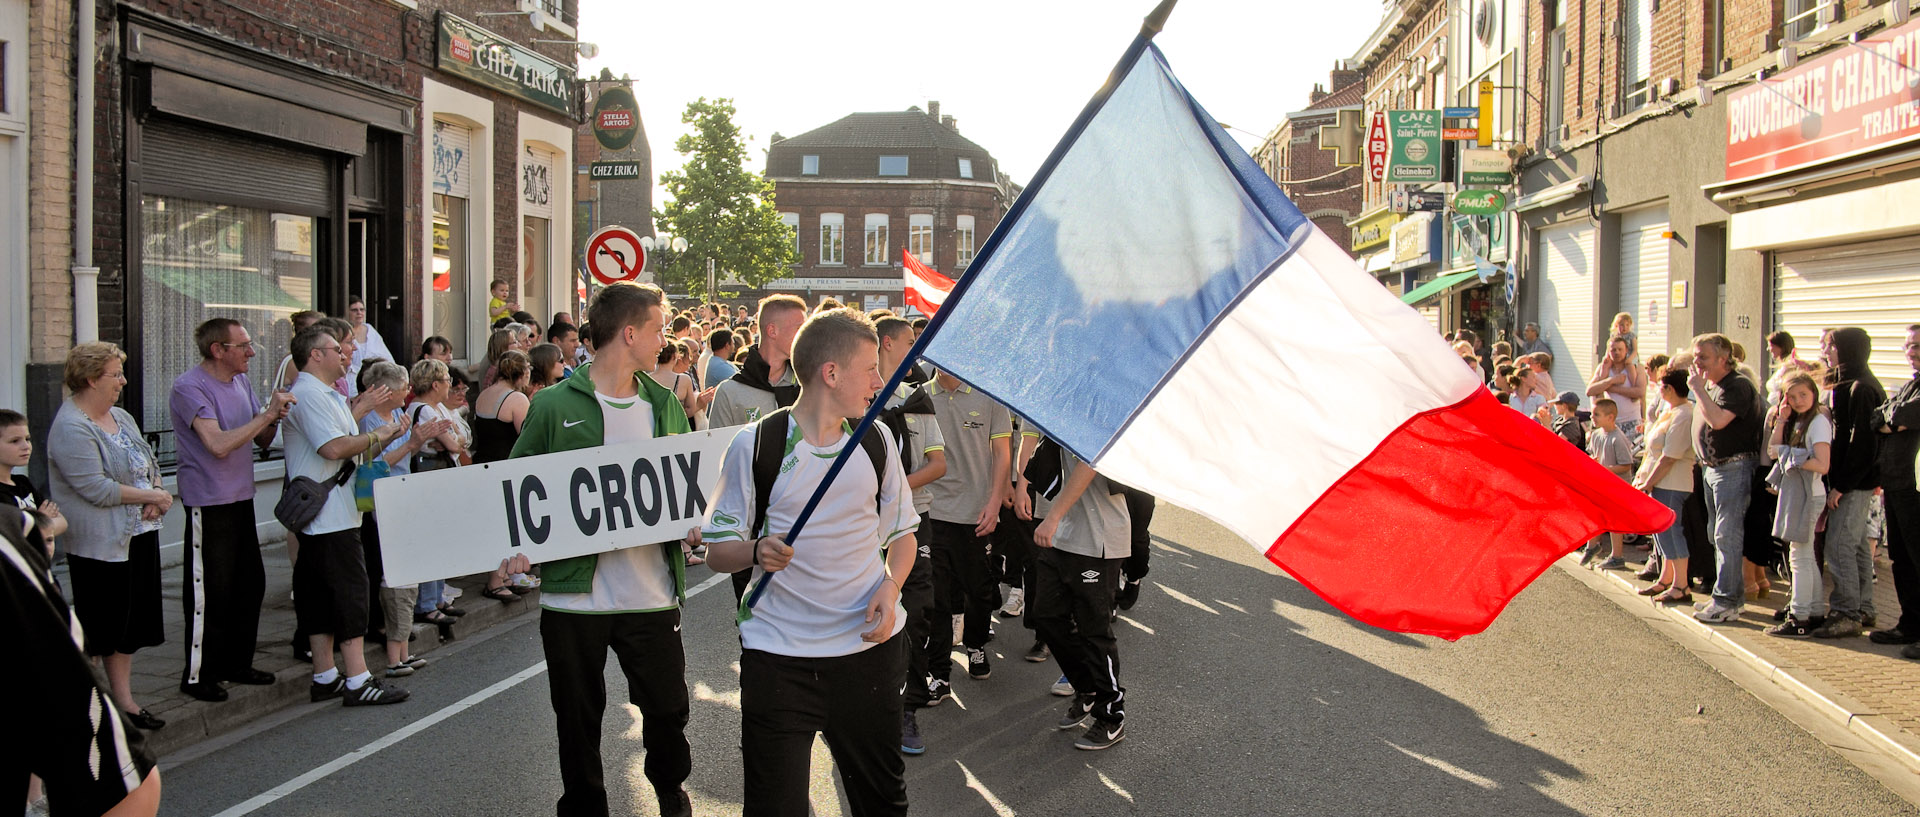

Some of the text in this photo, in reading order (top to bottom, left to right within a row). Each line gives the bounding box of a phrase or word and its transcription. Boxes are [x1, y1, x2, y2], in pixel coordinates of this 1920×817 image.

[454, 39, 470, 51] STELLA
[454, 48, 471, 60] ARTOIS
[476, 41, 567, 101] CHEZ ERIKA
[1729, 66, 1826, 145] BOUCHERIE
[1371, 113, 1386, 179] TABAC
[592, 165, 638, 176] CHEZ ERIKA
[1396, 168, 1432, 176] Heineken
[1457, 197, 1484, 208] PMU
[502, 451, 708, 547] IC CROIX
